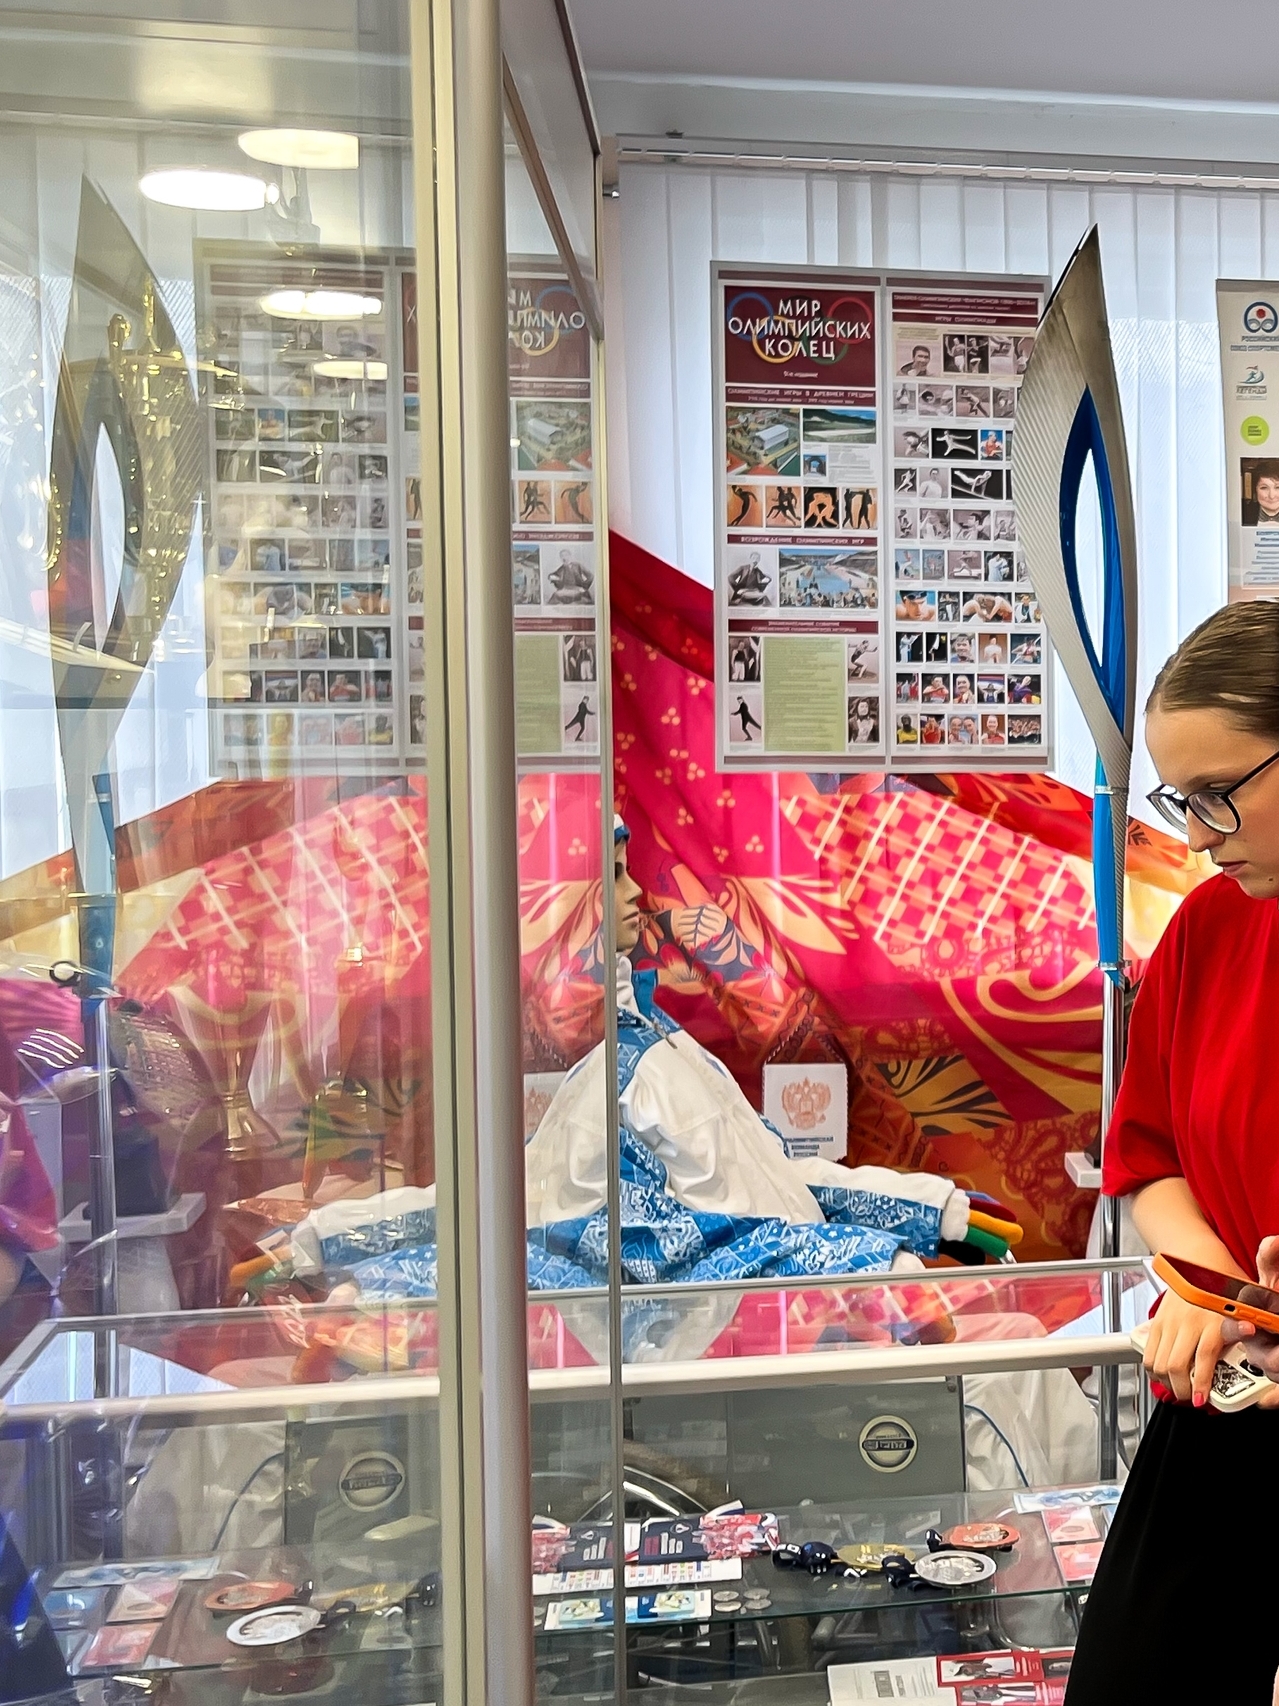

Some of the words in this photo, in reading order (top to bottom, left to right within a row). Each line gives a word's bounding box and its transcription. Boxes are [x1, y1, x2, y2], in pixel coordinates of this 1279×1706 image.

[778, 299, 821, 317] МИР
[728, 316, 871, 340] ОЛИМПИЙСКИХ
[765, 338, 835, 360] КОЛЕЦ
